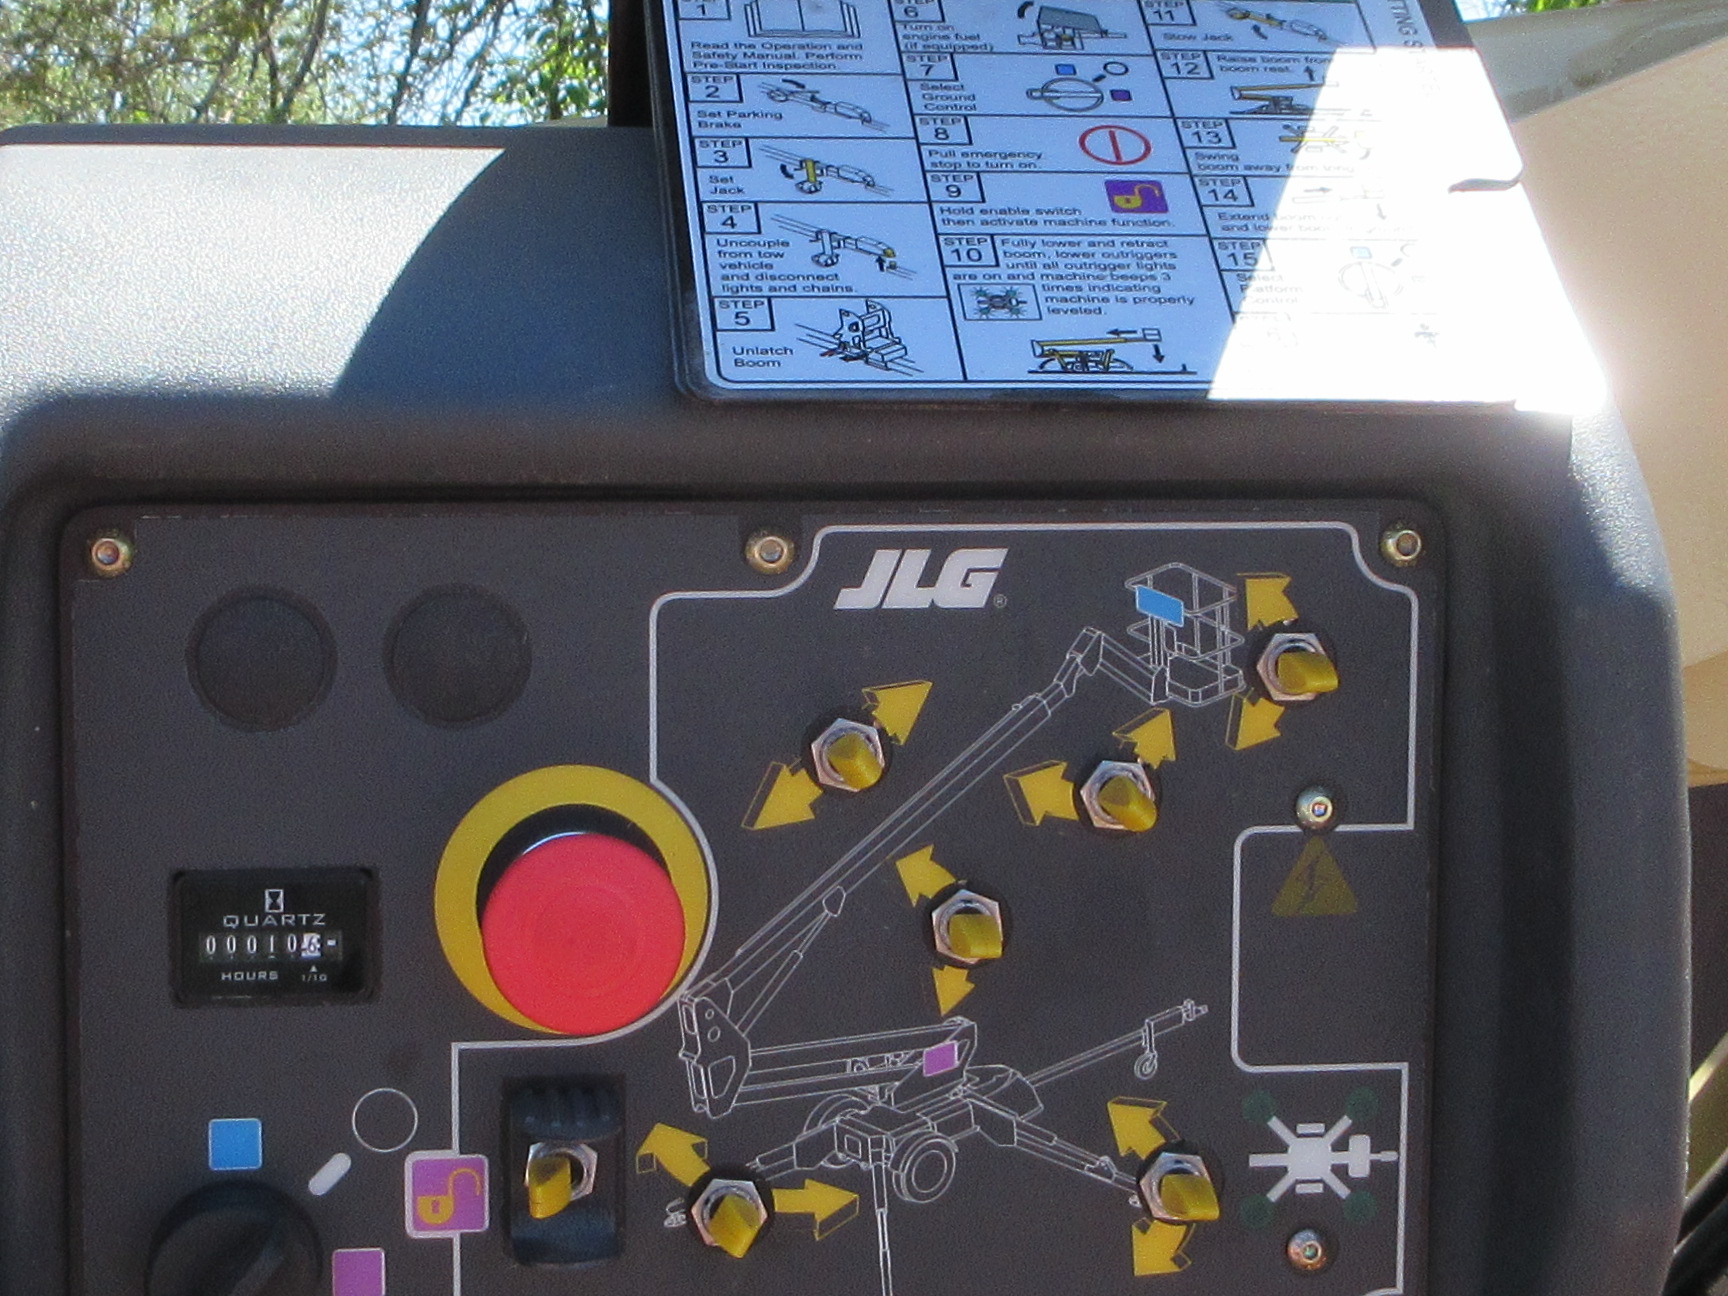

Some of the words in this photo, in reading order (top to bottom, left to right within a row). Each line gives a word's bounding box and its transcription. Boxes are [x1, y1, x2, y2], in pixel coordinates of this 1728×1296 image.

[696, 5, 707, 16] 1
[904, 6, 920, 18] 6
[1153, 10, 1176, 22] 11
[902, 34, 954, 44] engine
[956, 33, 980, 42] fuel
[691, 41, 729, 51] Read
[734, 41, 756, 51] the
[761, 42, 834, 53] Operation
[837, 42, 864, 51] and
[692, 51, 737, 62] Safety
[906, 55, 948, 63] STEP
[1261, 55, 1300, 64] boom
[920, 64, 934, 76] 7
[1171, 62, 1201, 75] 12
[1220, 64, 1259, 73] boom
[691, 75, 733, 84] STEP
[705, 85, 720, 99] 2
[920, 83, 965, 92] Select
[922, 93, 976, 102] Ground
[924, 103, 977, 112] Control
[697, 110, 723, 119] Set
[726, 110, 783, 121] Parking
[697, 120, 742, 129] Brake
[919, 117, 962, 126] STEP
[1181, 121, 1223, 129] STEP
[934, 128, 950, 141] 8
[1191, 131, 1222, 144] 13
[699, 139, 743, 149] STEP
[713, 150, 729, 164] 3
[928, 149, 956, 159] Pull
[960, 150, 1042, 161] emergency
[930, 160, 962, 171] stop
[985, 161, 1015, 170] turn
[1198, 163, 1240, 172] boom
[1243, 164, 1282, 174] away
[709, 175, 735, 184] Set
[931, 174, 974, 184] STEP
[1198, 179, 1242, 188] STEP
[710, 185, 745, 195] Jack
[946, 185, 962, 198] 9
[1208, 189, 1239, 202] 14
[707, 204, 752, 214] STEP
[940, 207, 974, 216] Hold
[980, 207, 1030, 216] enable
[1035, 207, 1082, 216] switch
[1218, 212, 1270, 222] Extend
[722, 216, 737, 229] 4
[942, 218, 976, 227] then
[980, 218, 1038, 227] activate
[1044, 218, 1106, 227] machine
[1222, 223, 1250, 232] and
[717, 238, 790, 249] Uncouple
[943, 237, 988, 247] STEP
[1001, 239, 1037, 249] Fully
[1041, 239, 1082, 248] lower
[1088, 239, 1116, 248] and
[1120, 239, 1169, 248] retract
[1218, 241, 1262, 251] STEP
[718, 249, 754, 259] from
[757, 250, 785, 259] tow
[950, 248, 983, 262] 10
[1056, 250, 1095, 259] lower
[1100, 251, 1178, 261] outriggers
[1227, 253, 1258, 267] 15
[720, 261, 774, 270] vehicle
[1006, 261, 1038, 270] until
[1064, 261, 1131, 272] outrigger
[1136, 261, 1177, 271] lights
[722, 273, 751, 282] and
[755, 272, 840, 282] disconnect
[953, 273, 978, 281] are
[983, 273, 1002, 281] on
[1007, 272, 1035, 281] and
[1040, 272, 1104, 281] machine
[1110, 272, 1157, 283] beeps
[722, 283, 763, 293] lights
[768, 283, 798, 293] and
[1042, 284, 1083, 293] times
[1087, 284, 1162, 294] indicating
[719, 300, 765, 309] STEP
[1045, 295, 1111, 304] machine
[1133, 295, 1195, 306] properly
[734, 312, 751, 326] 5
[733, 346, 794, 356] Unlatch
[734, 359, 782, 368] Boom
[834, 548, 1009, 610] JLG
[223, 913, 326, 929] QUARTZ
[221, 971, 279, 981] HOURS
